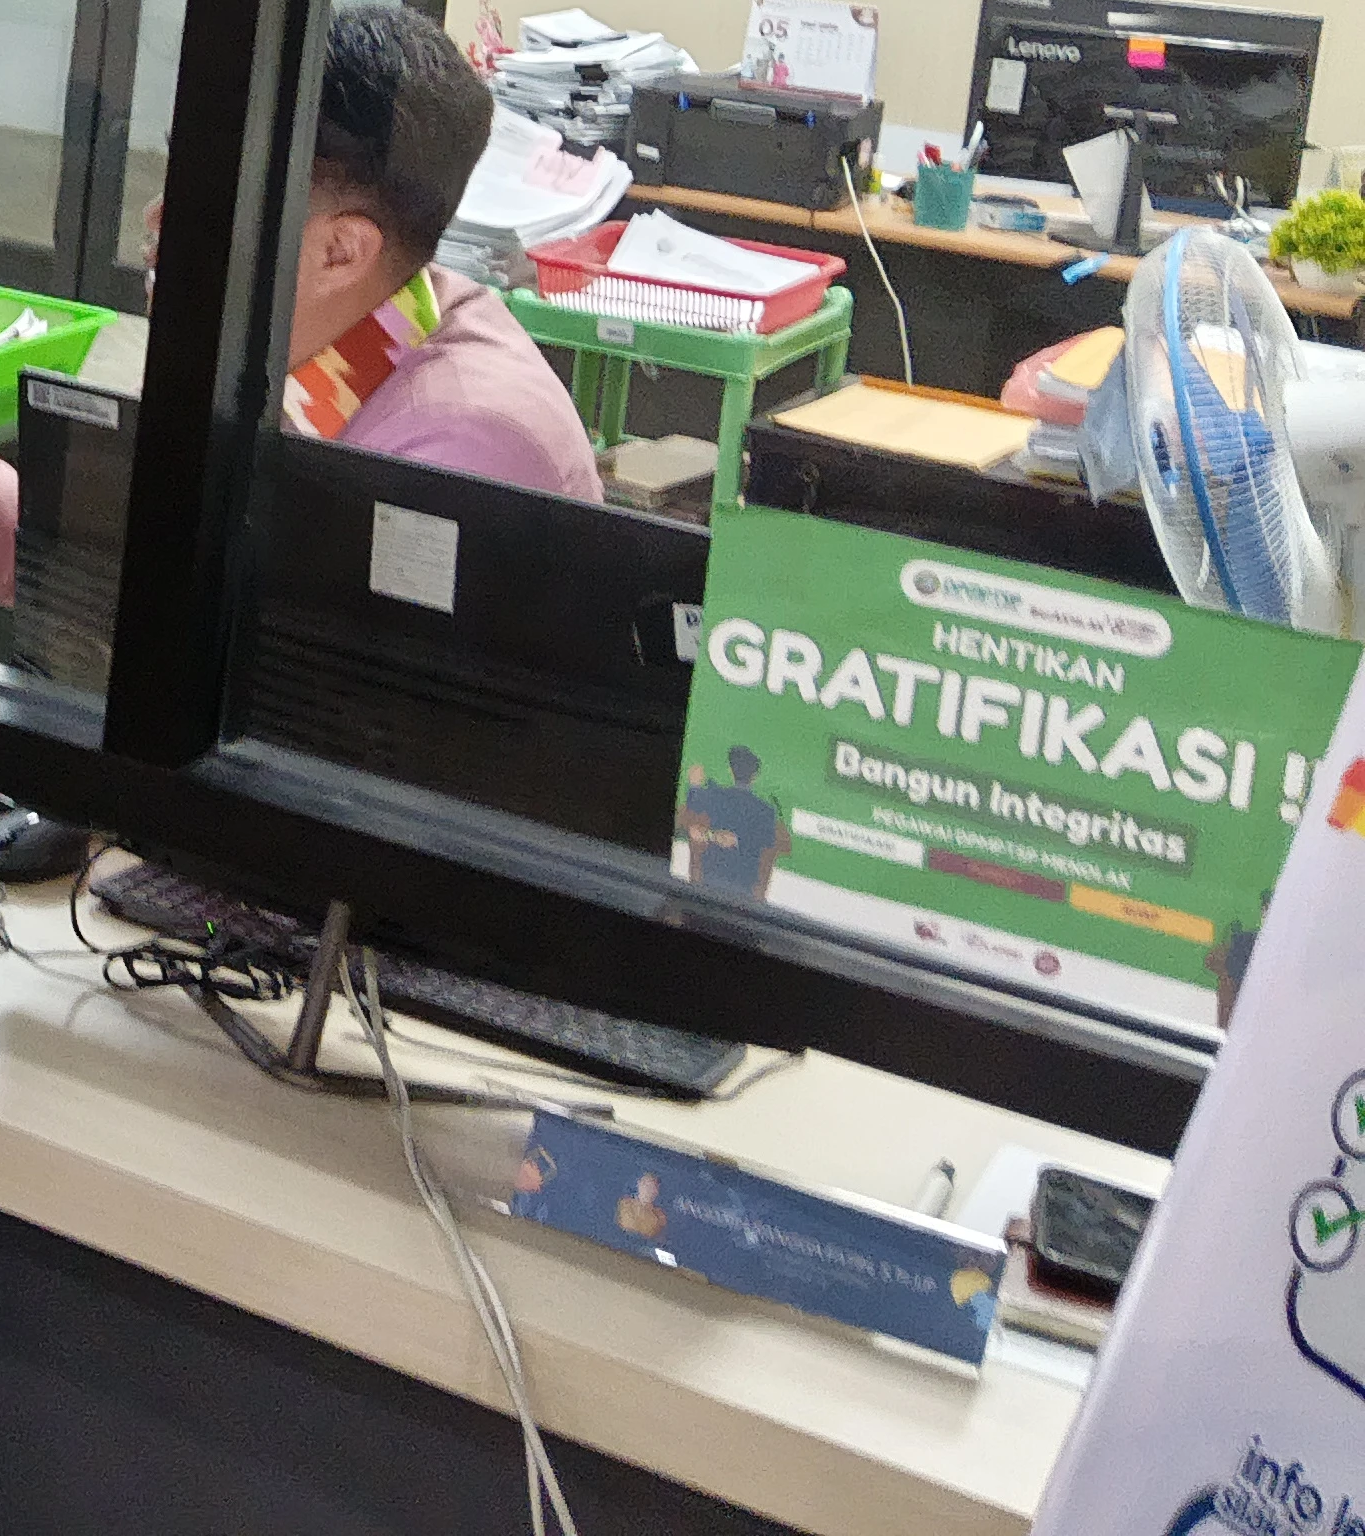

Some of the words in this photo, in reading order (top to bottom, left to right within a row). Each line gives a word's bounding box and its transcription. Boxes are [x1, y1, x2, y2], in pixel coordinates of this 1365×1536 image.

[758, 17, 789, 39] 05
[1007, 35, 1081, 63] Lenovo
[933, 620, 1125, 694] HENTIKAN
[707, 616, 1257, 812] GRATIFIKASI
[989, 784, 1188, 864] Integritas
